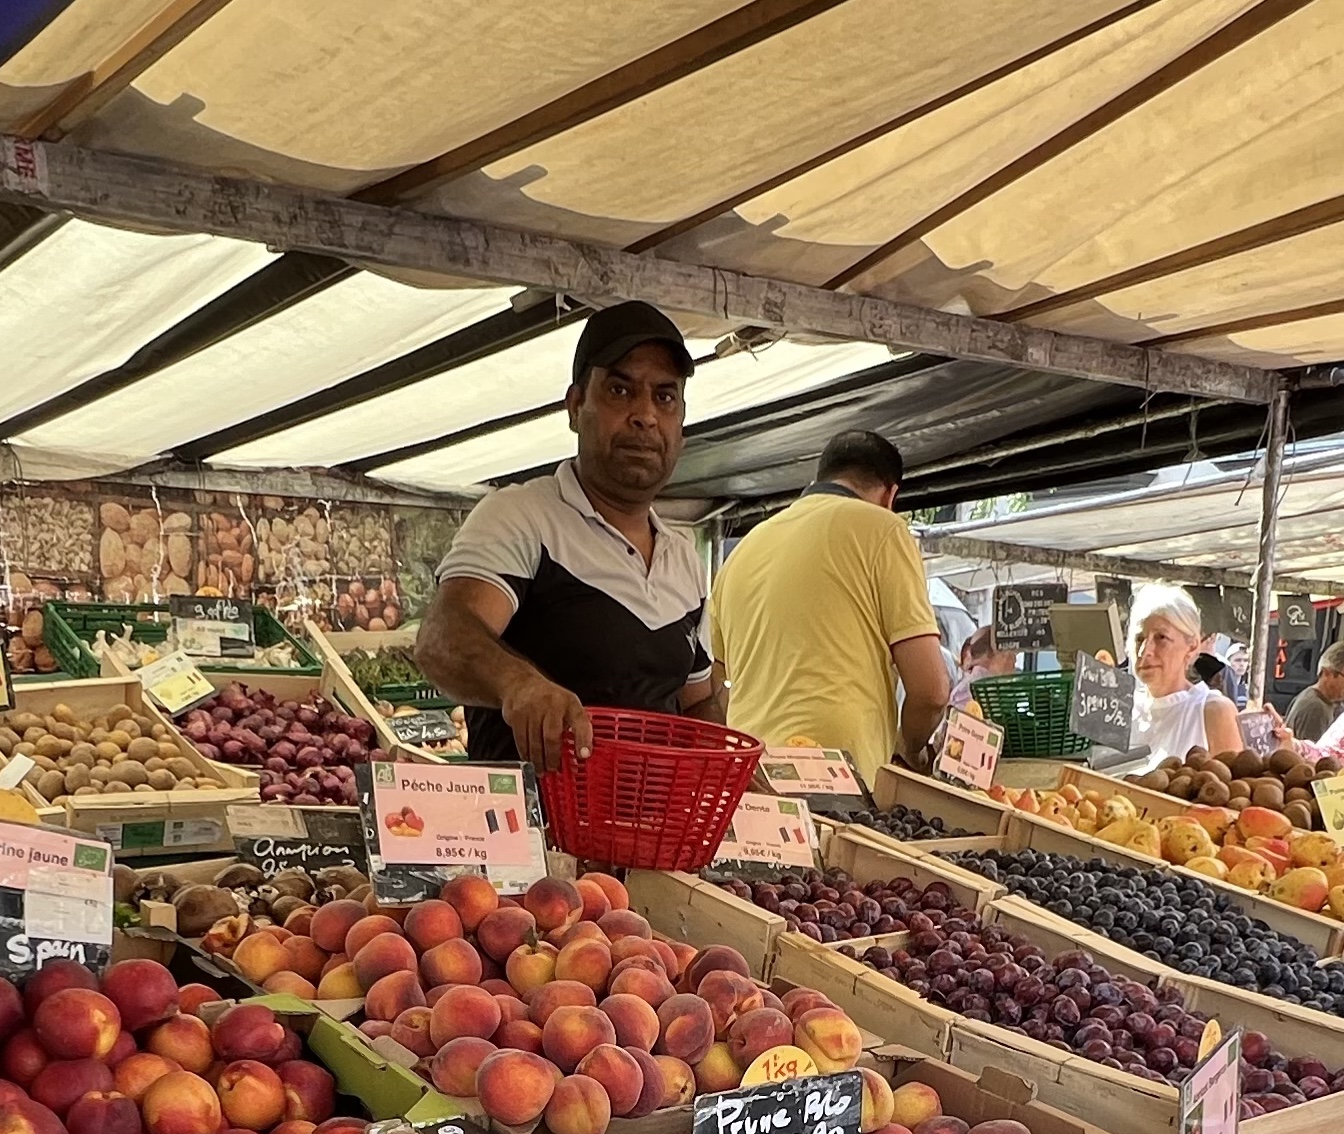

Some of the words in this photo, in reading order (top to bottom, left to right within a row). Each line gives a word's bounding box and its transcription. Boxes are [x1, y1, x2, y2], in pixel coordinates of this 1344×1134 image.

[447, 781, 485, 795] Jaune
[28, 846, 69, 867] jaune
[475, 848, 488, 860] kg
